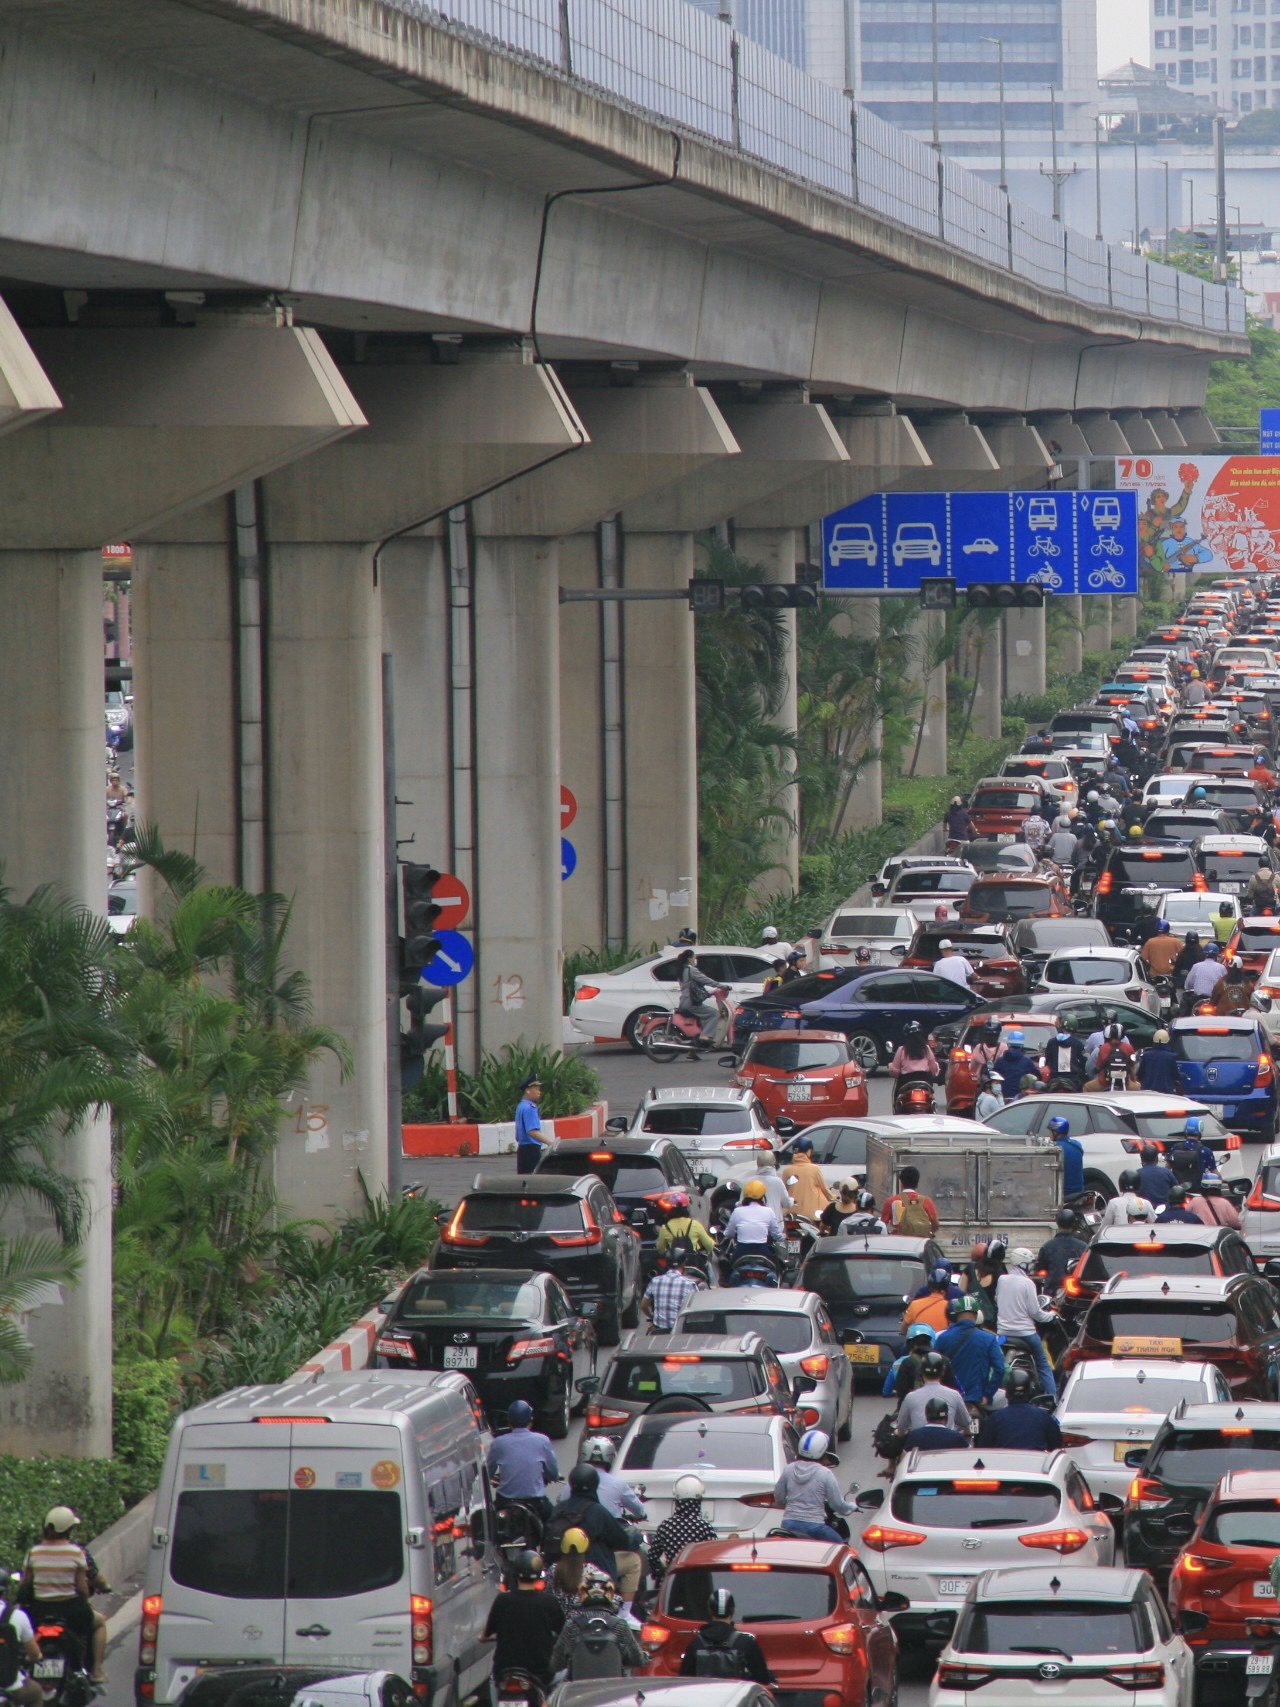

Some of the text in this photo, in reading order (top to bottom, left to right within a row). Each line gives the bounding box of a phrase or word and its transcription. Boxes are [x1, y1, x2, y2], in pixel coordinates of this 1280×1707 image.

[1118, 458, 1153, 480] 70
[106, 545, 124, 553] 1800
[489, 973, 527, 1005] 12
[295, 1104, 330, 1134] 13
[452, 1348, 468, 1357] 29A
[445, 1357, 475, 1368] 897.10
